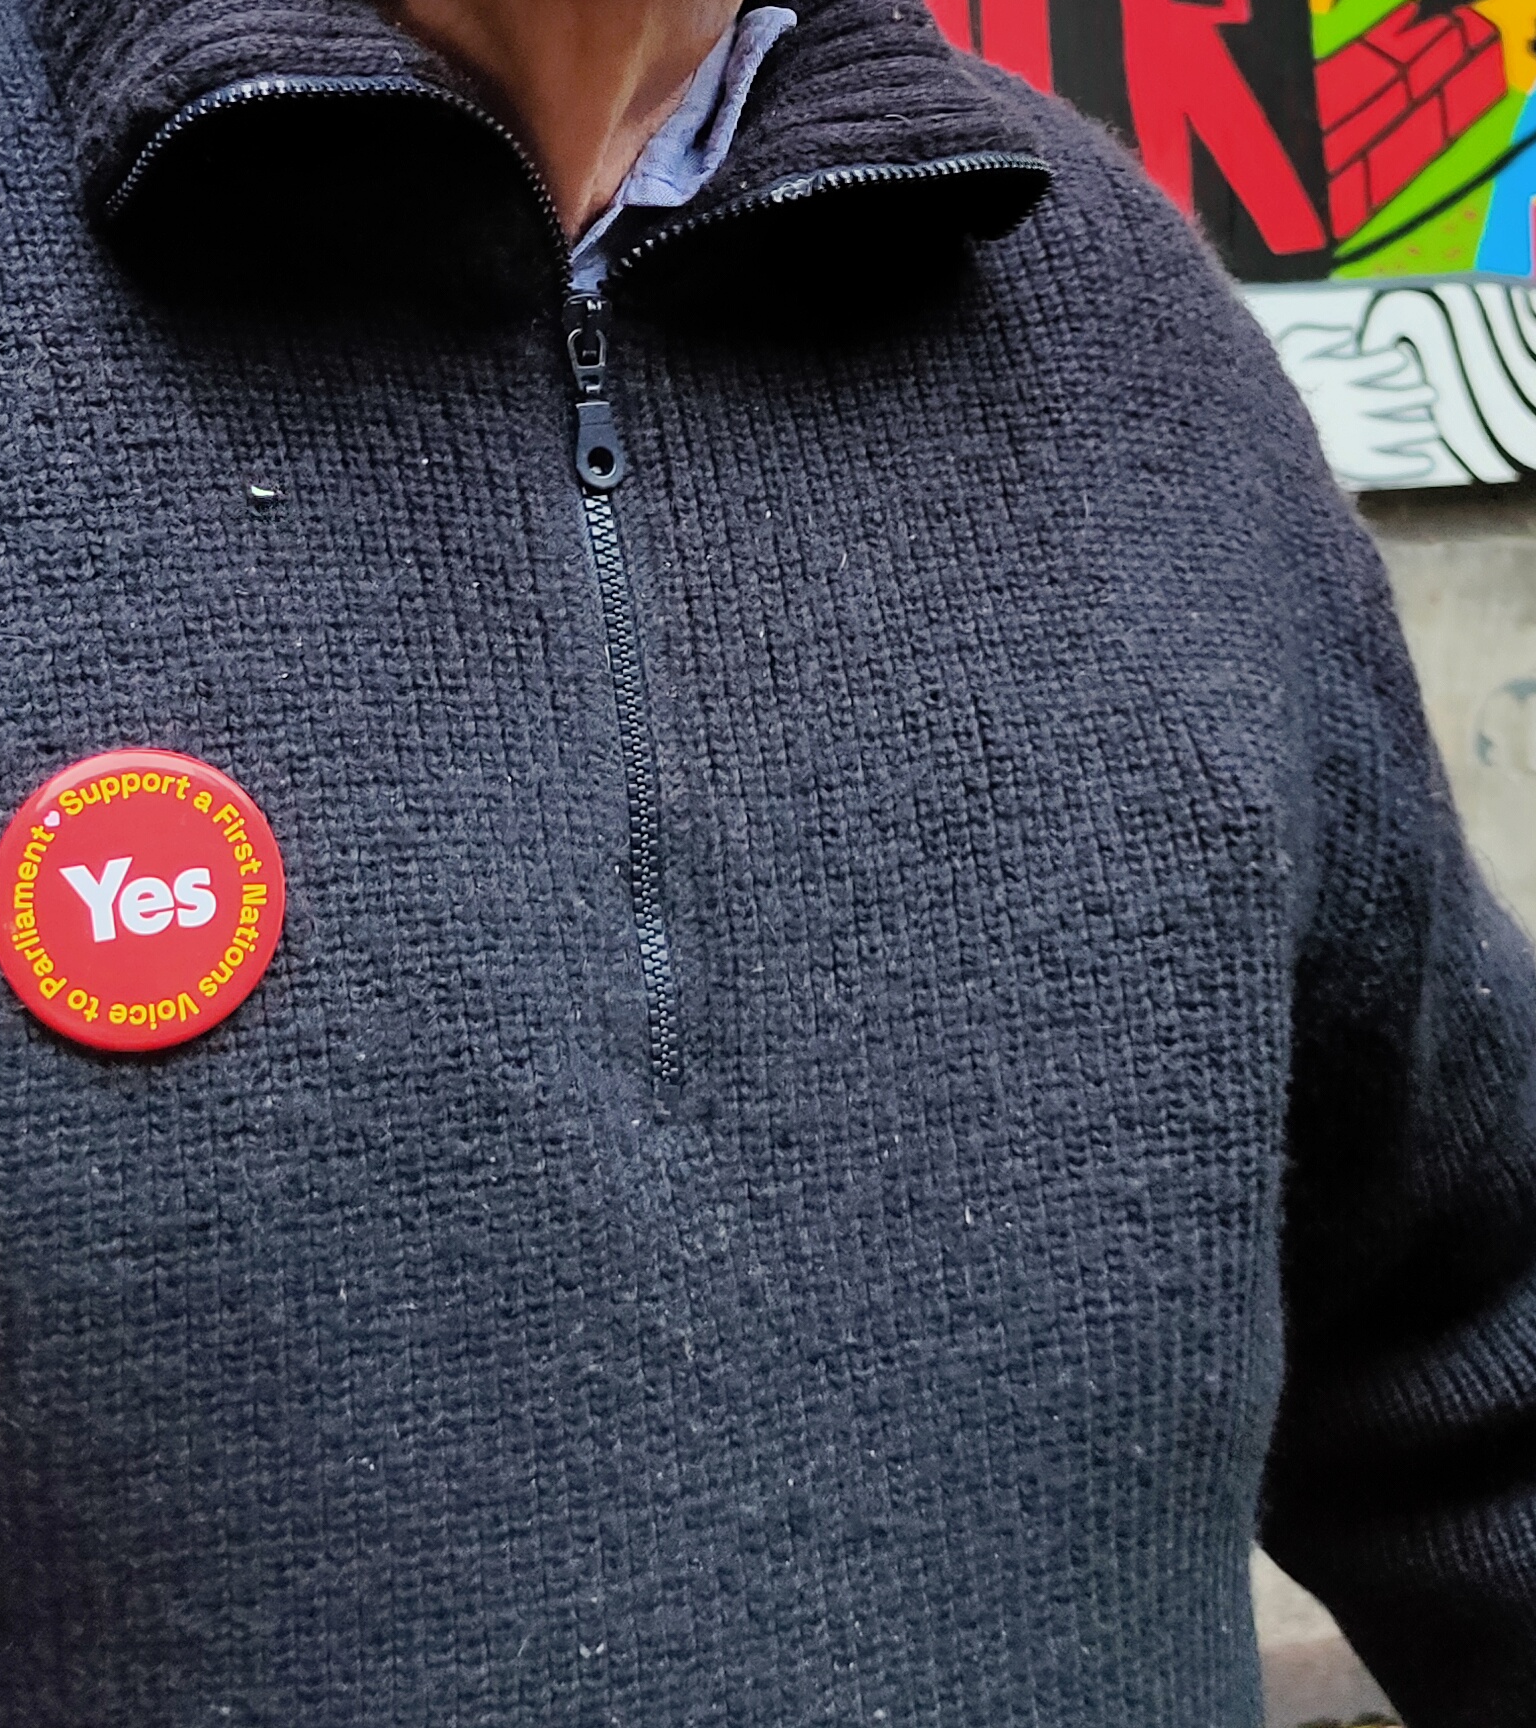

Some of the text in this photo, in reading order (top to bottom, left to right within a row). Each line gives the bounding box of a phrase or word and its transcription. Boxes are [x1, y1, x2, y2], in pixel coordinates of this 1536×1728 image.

[11, 772, 268, 1031] Support a First Nations Voice to Parliament
[59, 856, 218, 944] Yes
